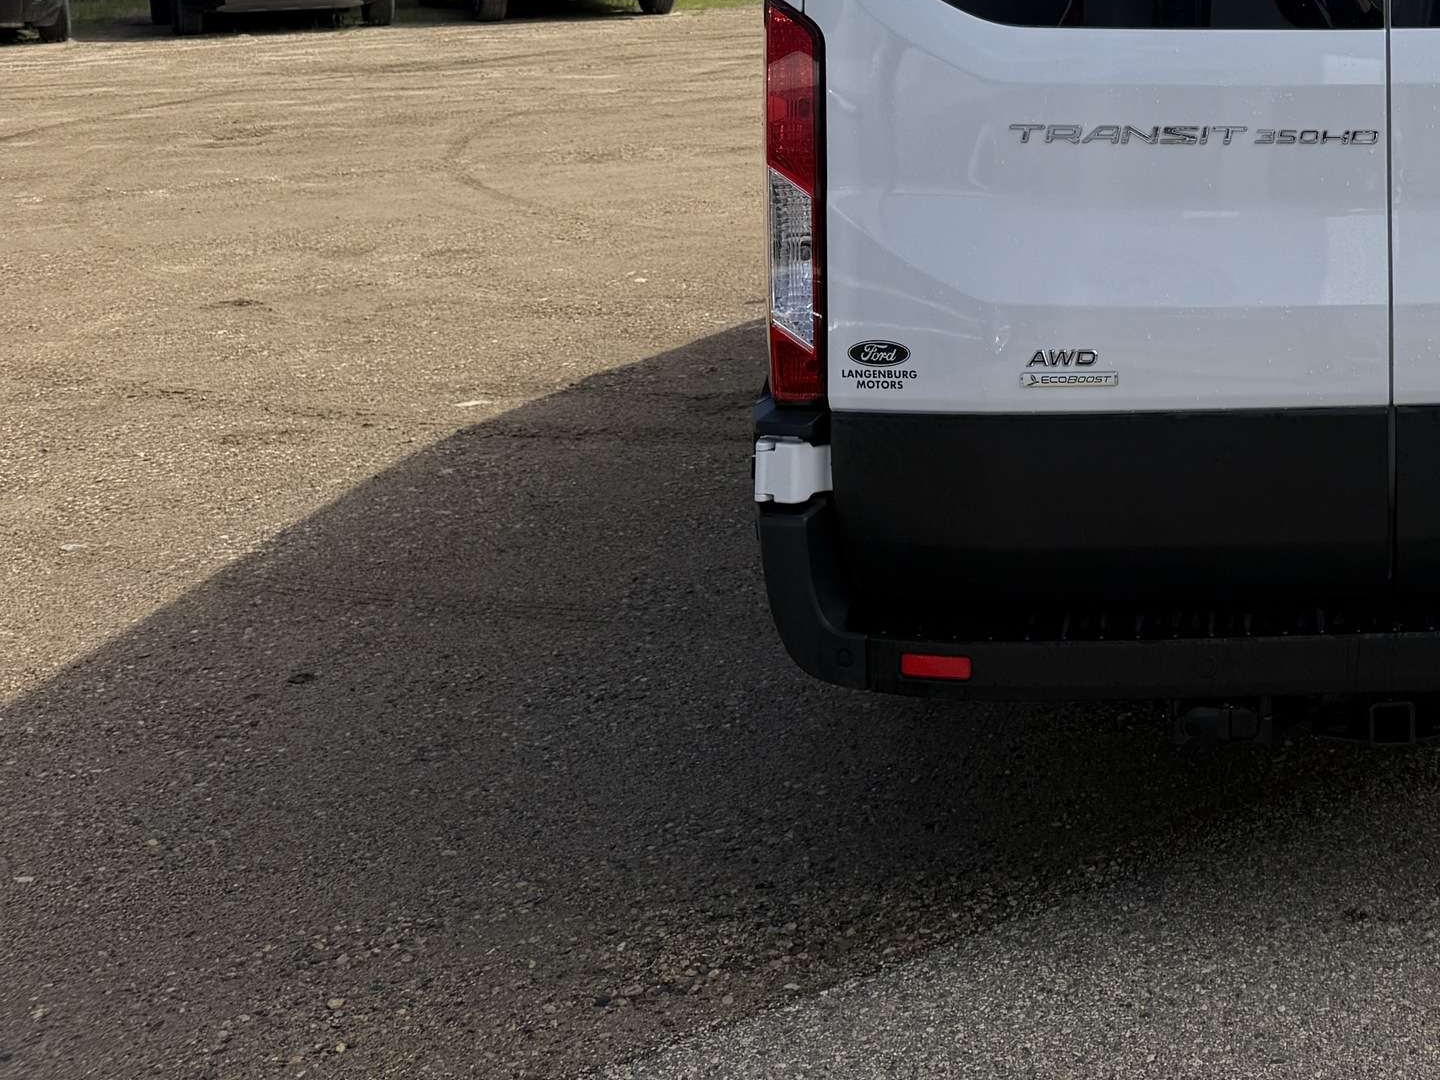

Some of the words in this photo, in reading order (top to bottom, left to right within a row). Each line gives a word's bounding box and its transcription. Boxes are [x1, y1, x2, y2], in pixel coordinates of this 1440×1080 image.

[1009, 123, 1248, 145] TRANSIT
[1254, 128, 1379, 145] 350HD
[860, 343, 897, 362] Ford
[1026, 349, 1098, 367] AWD
[841, 369, 917, 379] LANGENBURG
[1041, 375, 1112, 384] ECOBOOST
[856, 380, 903, 390] MOTORS
